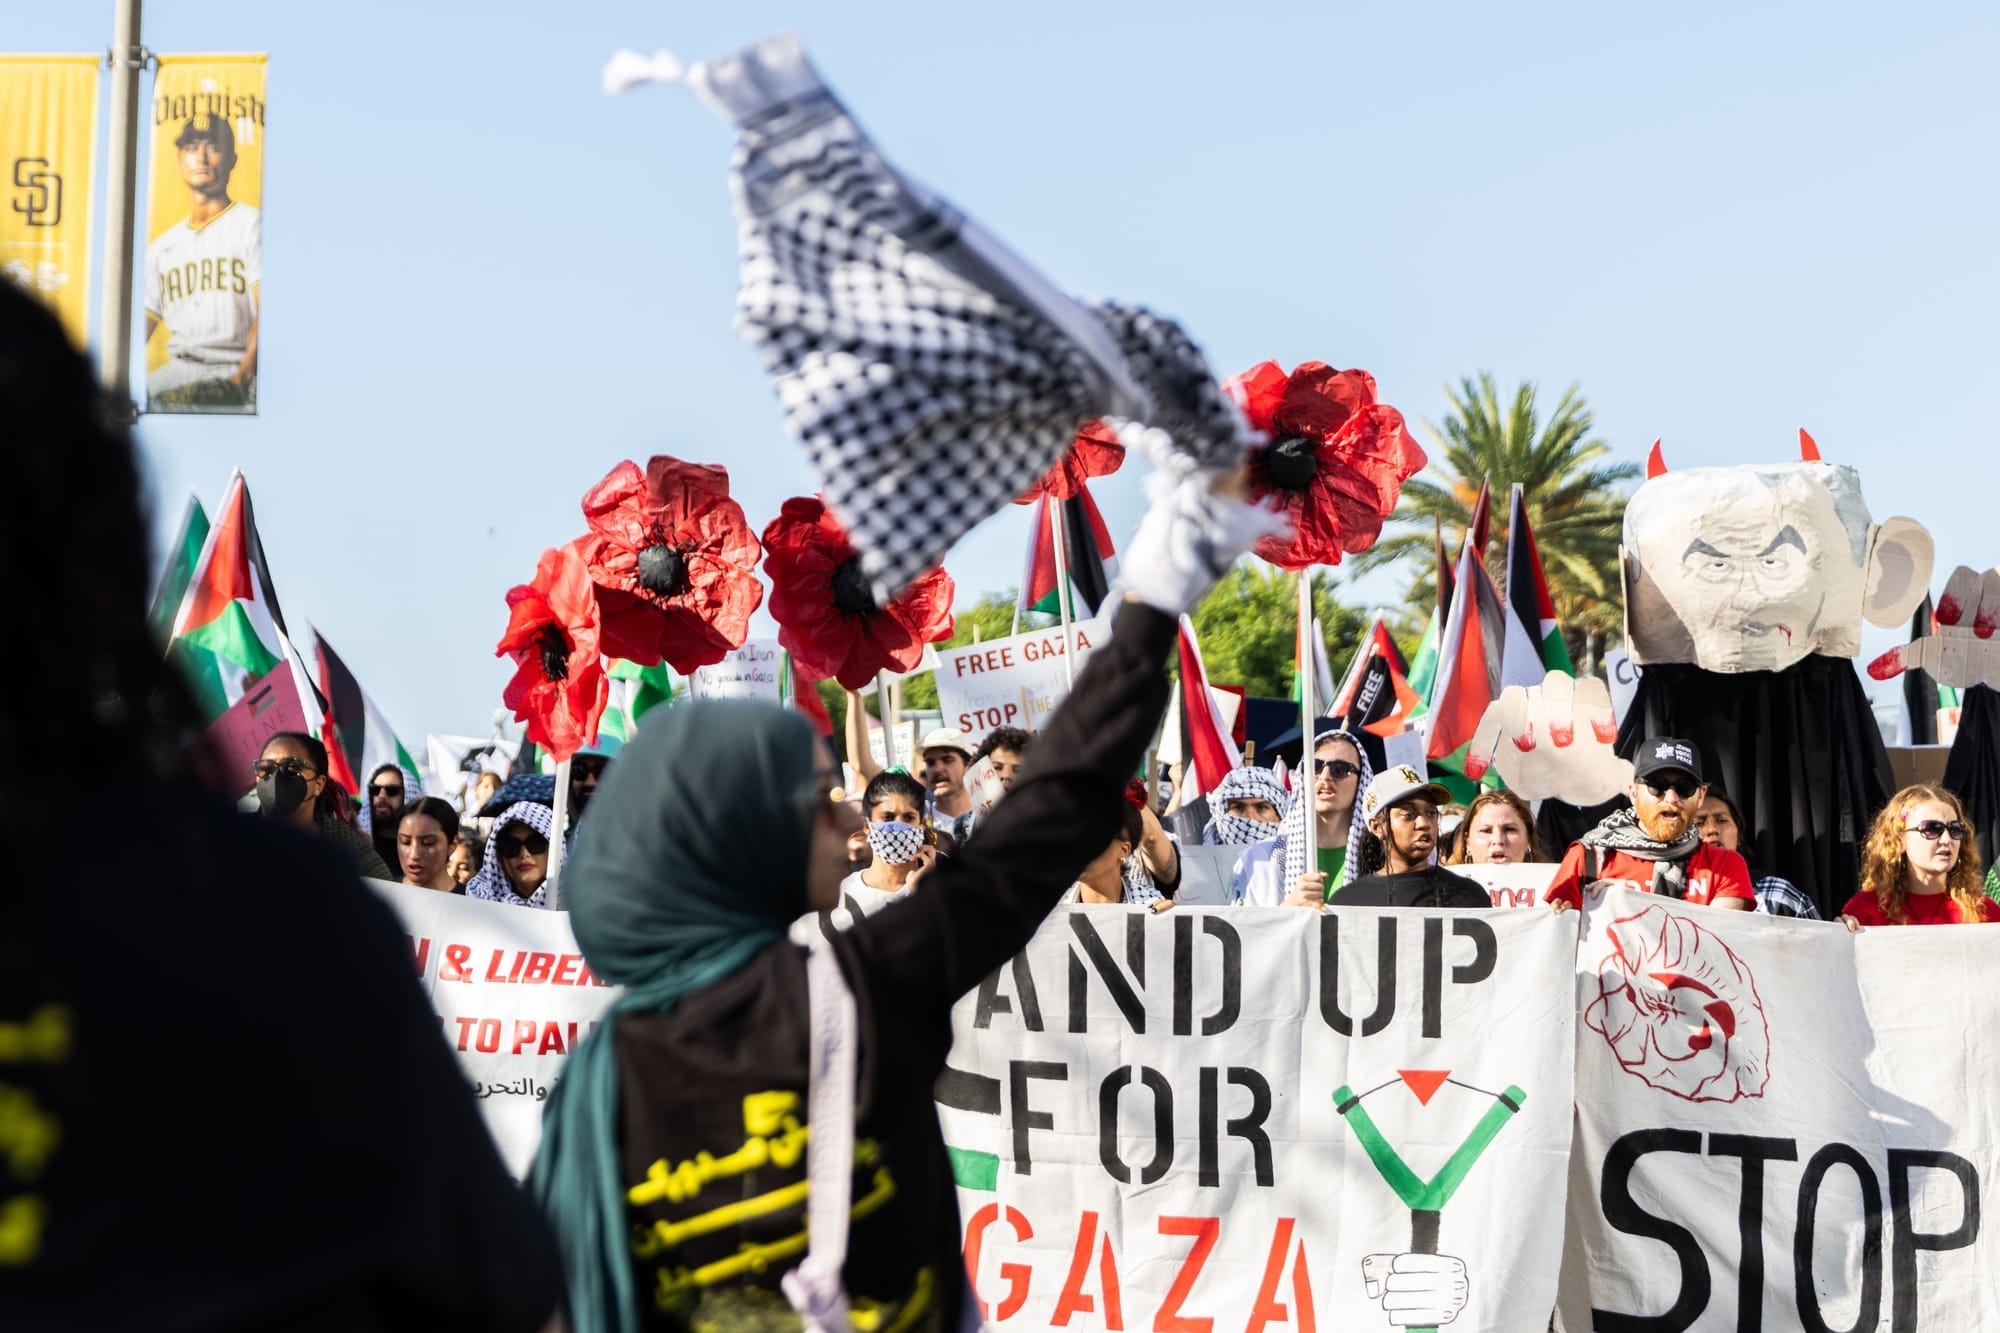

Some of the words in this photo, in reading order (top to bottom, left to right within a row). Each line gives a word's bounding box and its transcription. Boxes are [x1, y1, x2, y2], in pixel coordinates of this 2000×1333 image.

[13, 157, 62, 227] SD
[159, 257, 246, 310] PADRES
[954, 647, 1015, 677] FREE
[1024, 630, 1092, 662] GAZA
[1356, 669, 1384, 712] FREE
[959, 703, 1018, 733] STOP
[439, 944, 473, 984] &
[973, 912, 1242, 1036] AND
[1320, 914, 1497, 1038] UP
[455, 1017, 502, 1053] TO
[473, 1077, 548, 1101] والتحري
[1009, 1060, 1274, 1187] FOR
[1592, 1127, 1981, 1333] STOP
[963, 1202, 1317, 1333] GAZA
